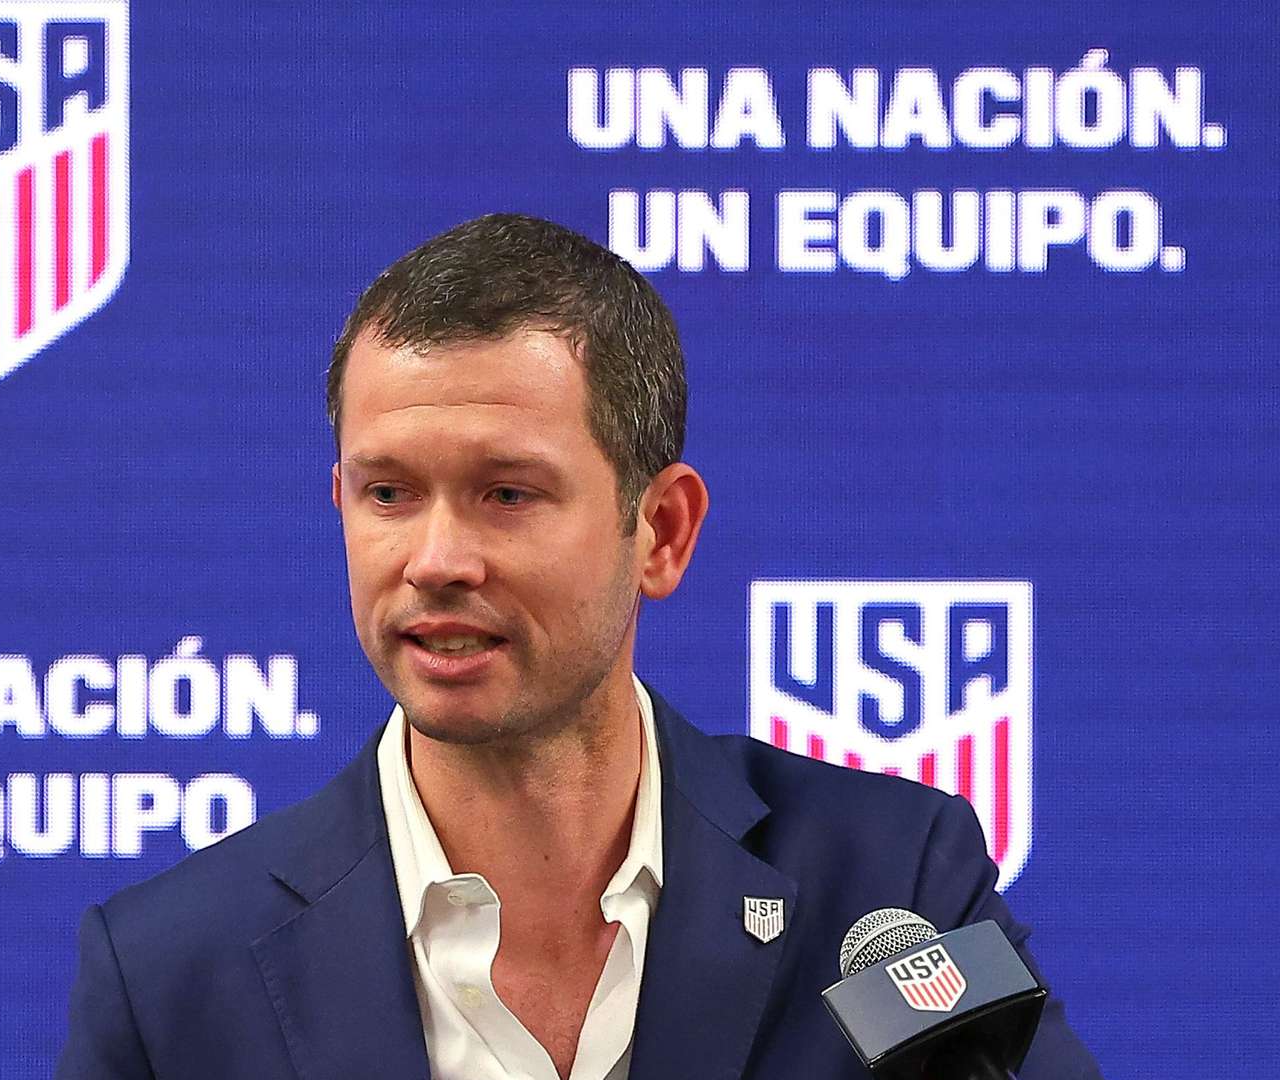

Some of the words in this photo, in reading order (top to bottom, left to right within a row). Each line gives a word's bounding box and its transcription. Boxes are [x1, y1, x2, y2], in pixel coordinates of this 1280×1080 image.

[568, 68, 785, 149] UNA
[807, 49, 1227, 149] NACIÓN.
[609, 189, 749, 273] UN
[775, 188, 1185, 281] EQUIPO.
[771, 602, 1012, 743] USA
[891, 948, 947, 982] USA
